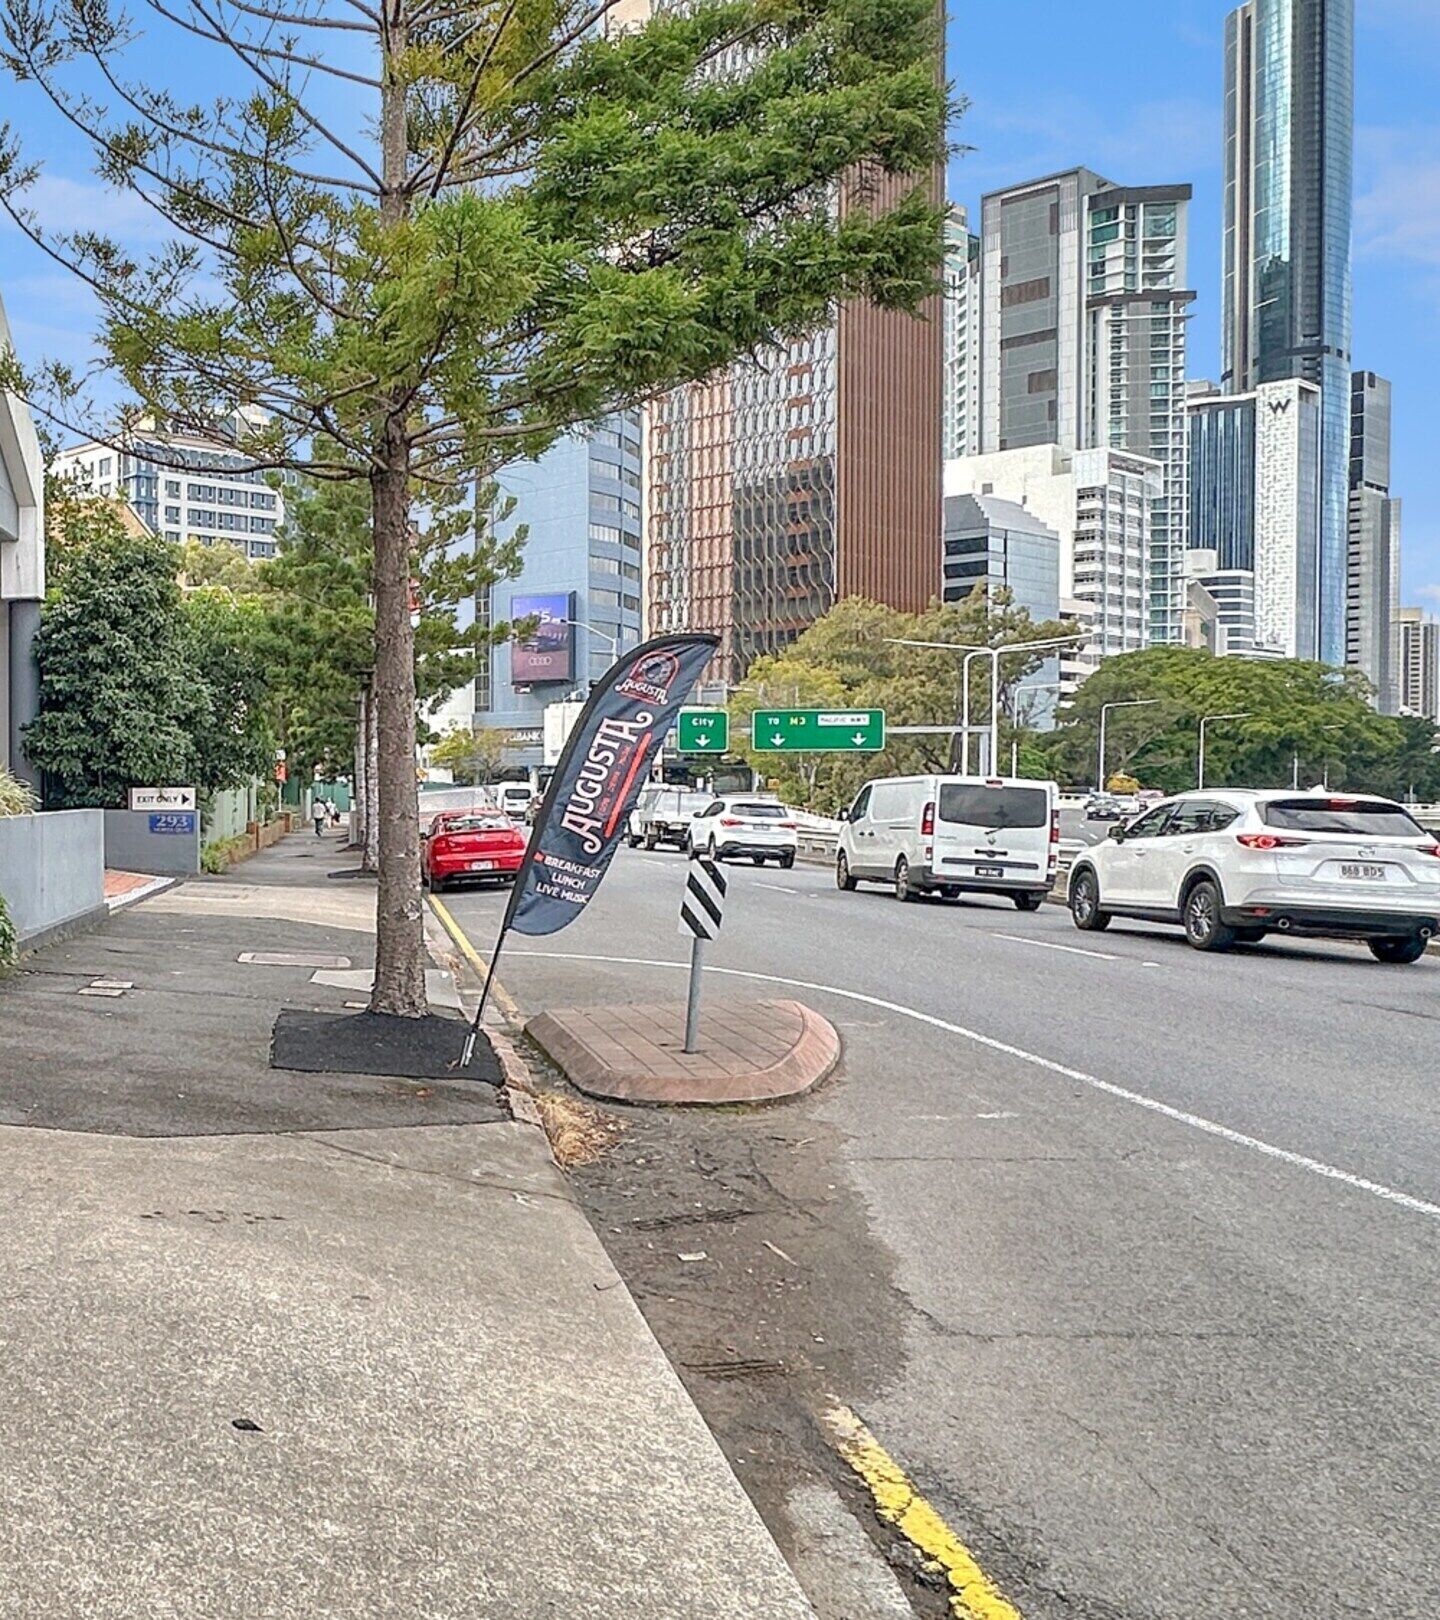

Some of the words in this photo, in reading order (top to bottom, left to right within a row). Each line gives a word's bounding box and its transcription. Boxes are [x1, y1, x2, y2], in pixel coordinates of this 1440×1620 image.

[1268, 398, 1291, 414] W
[614, 678, 669, 706] AUGUSTA
[691, 717, 715, 728] City
[767, 717, 780, 726] TO
[789, 717, 806, 726] M3
[561, 711, 654, 855] AUGUSTA
[137, 795, 155, 803] EXIT
[156, 795, 179, 803] ONLY
[156, 815, 189, 828] 293
[544, 855, 602, 879] BREAKFAST
[551, 871, 586, 891] LUNCH
[536, 881, 560, 898] LIVE
[561, 889, 590, 904] MUSIC
